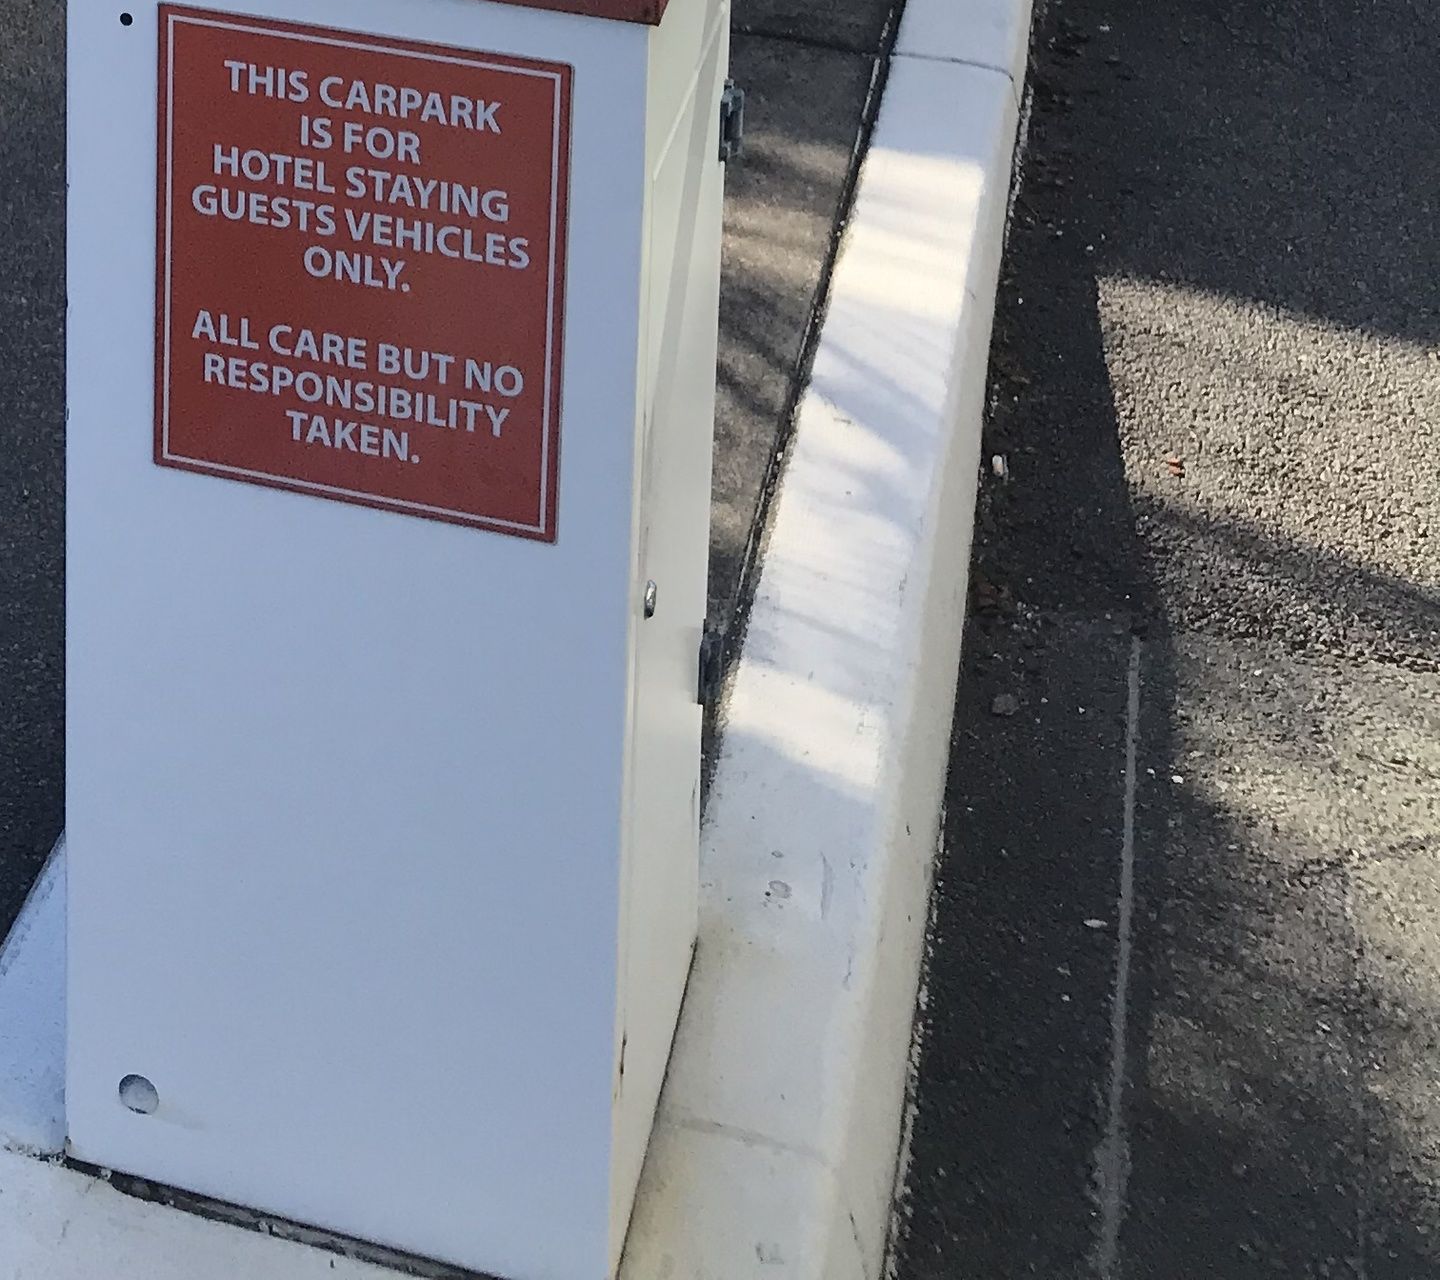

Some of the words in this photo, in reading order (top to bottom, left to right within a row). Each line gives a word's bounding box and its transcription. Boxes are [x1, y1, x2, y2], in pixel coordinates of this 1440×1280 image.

[224, 59, 308, 102] THIS
[319, 76, 501, 133] CARPARK
[300, 115, 332, 149] IS
[344, 122, 420, 164] FOR
[214, 144, 335, 193] HOTEL
[345, 167, 508, 221] STAYING
[192, 184, 335, 235] GUESTS
[345, 209, 530, 269] VEHICLES
[304, 246, 409, 292] ONLY.
[192, 310, 259, 349] ALL
[268, 324, 366, 369] CARE
[378, 344, 454, 384] BUT
[465, 359, 523, 397] NO
[204, 353, 509, 437] RESPONSIBILITY
[286, 410, 420, 463] TAKEN.
